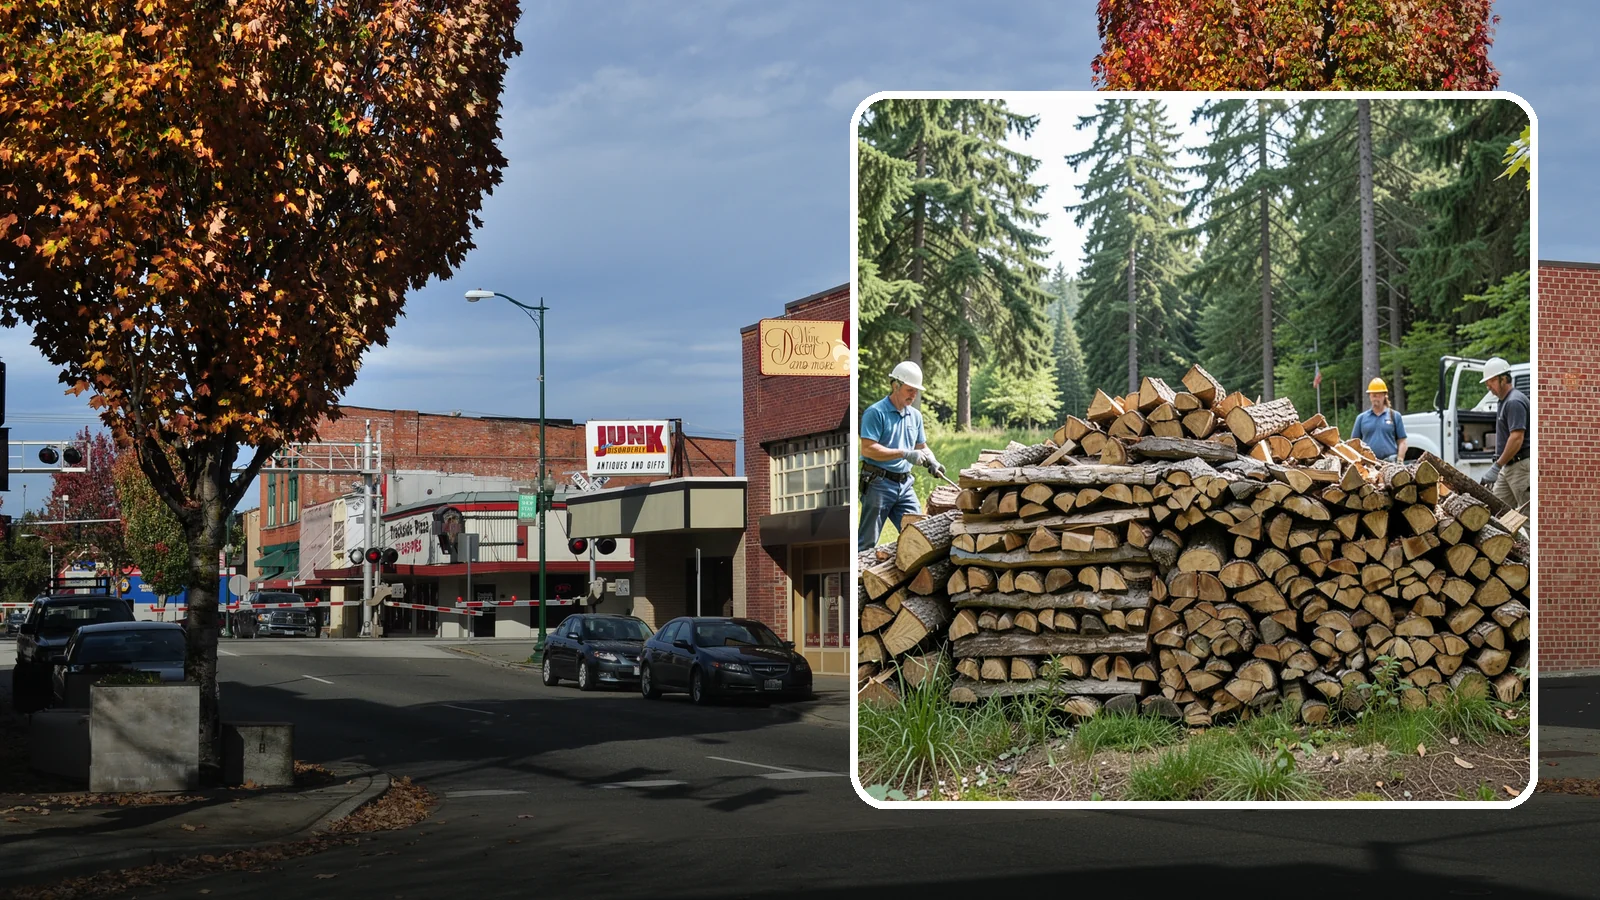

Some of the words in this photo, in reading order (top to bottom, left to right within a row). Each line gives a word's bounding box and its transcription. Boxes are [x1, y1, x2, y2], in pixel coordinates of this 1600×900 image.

[595, 425, 665, 457] JUNK
[597, 461, 628, 470] ANTIQUES
[631, 461, 644, 470] AND
[647, 460, 666, 470] GIFTS
[390, 521, 413, 540] Trackside
[414, 519, 429, 535] Pizza
